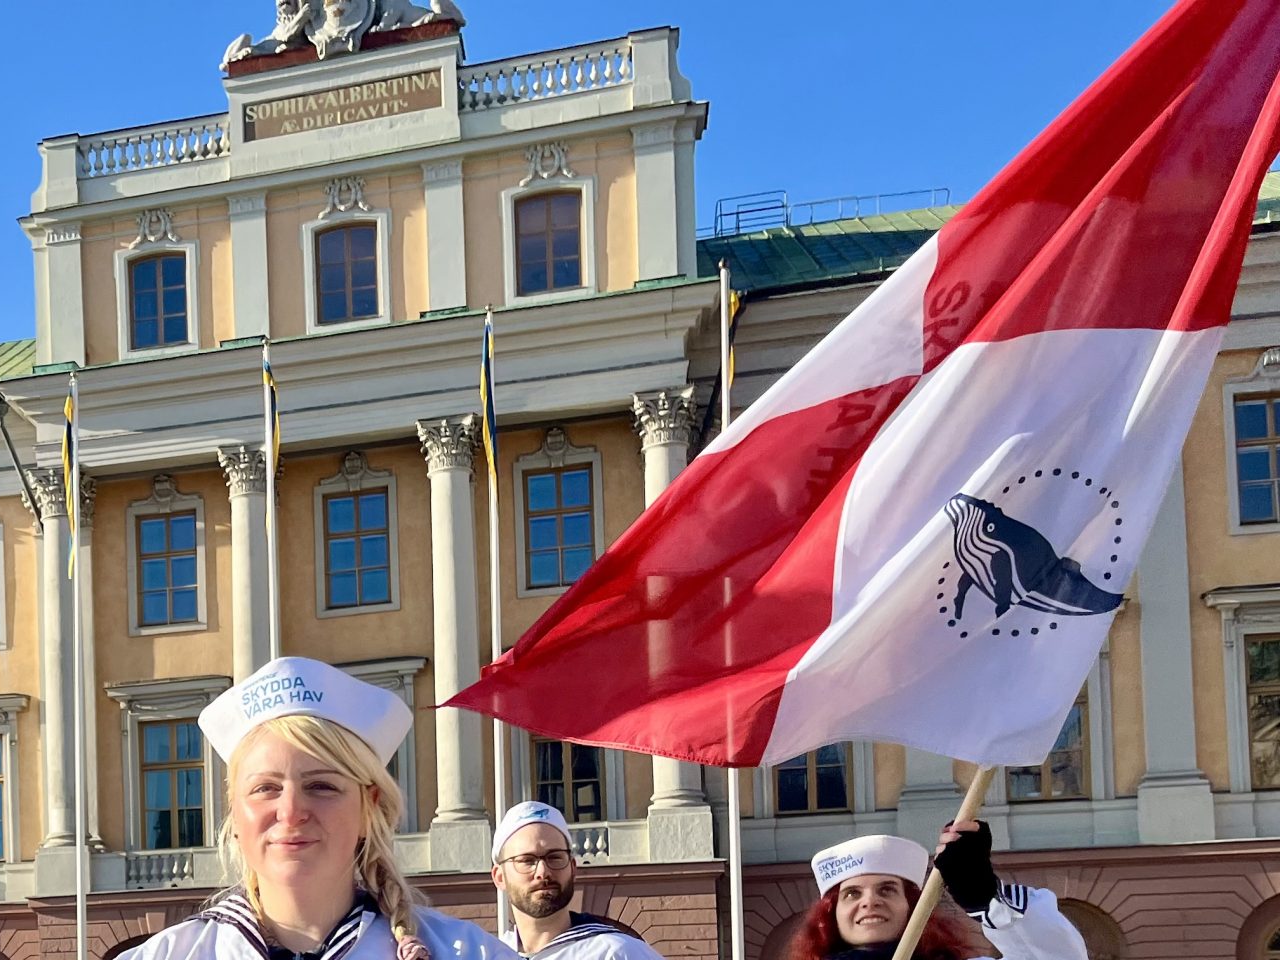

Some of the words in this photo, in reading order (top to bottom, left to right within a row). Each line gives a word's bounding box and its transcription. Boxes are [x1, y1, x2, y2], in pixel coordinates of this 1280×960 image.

[242, 676, 306, 705] SKYDDA
[244, 693, 285, 720] VÅRA
[289, 690, 324, 703] HAV
[845, 857, 864, 871] HAV
